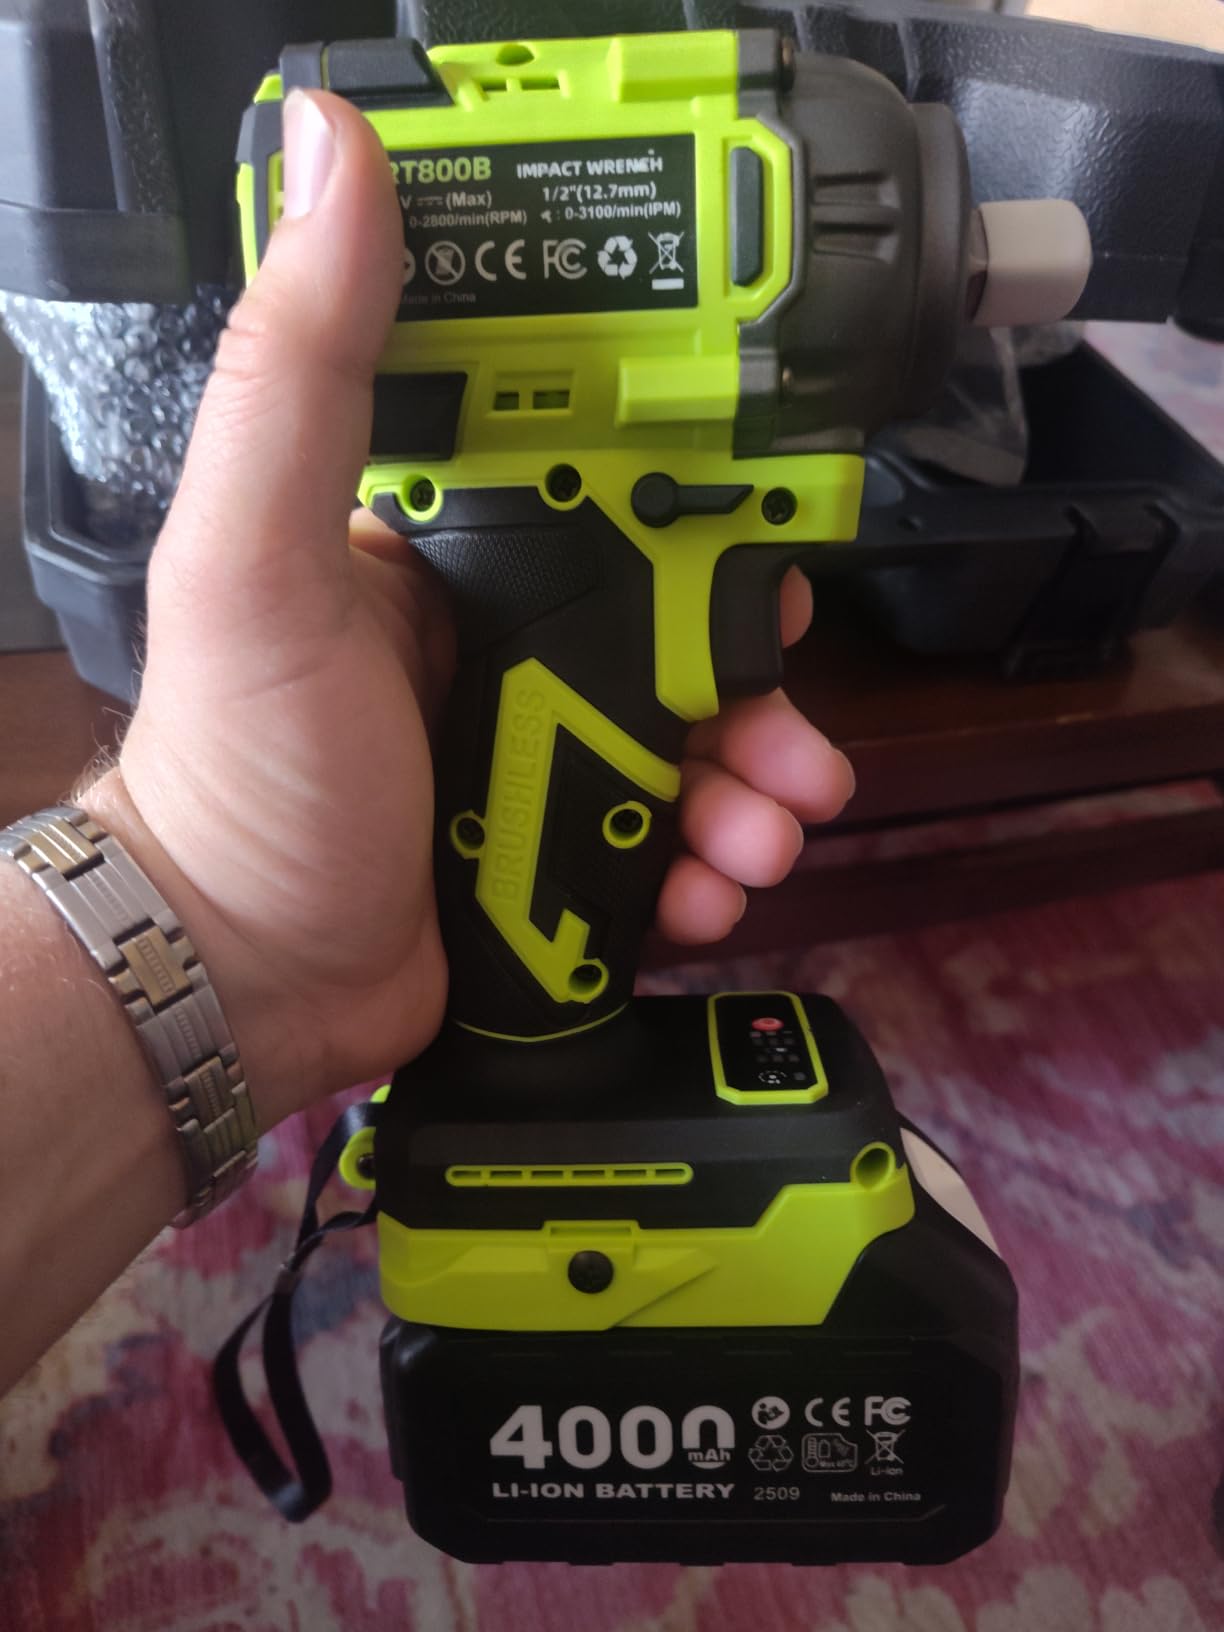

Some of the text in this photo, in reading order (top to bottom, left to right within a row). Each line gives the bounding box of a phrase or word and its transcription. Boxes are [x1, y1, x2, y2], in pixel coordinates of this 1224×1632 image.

[516, 160, 582, 179] IMPACT
[446, 190, 492, 211] (Max)
[443, 291, 476, 304] China
[491, 688, 546, 900] BRUSHLESS
[687, 1448, 731, 1462] mAh
[491, 1482, 736, 1499] LI-ION BATTERY
[753, 1486, 801, 1501] 2509
[830, 1491, 922, 1502] Made in China
